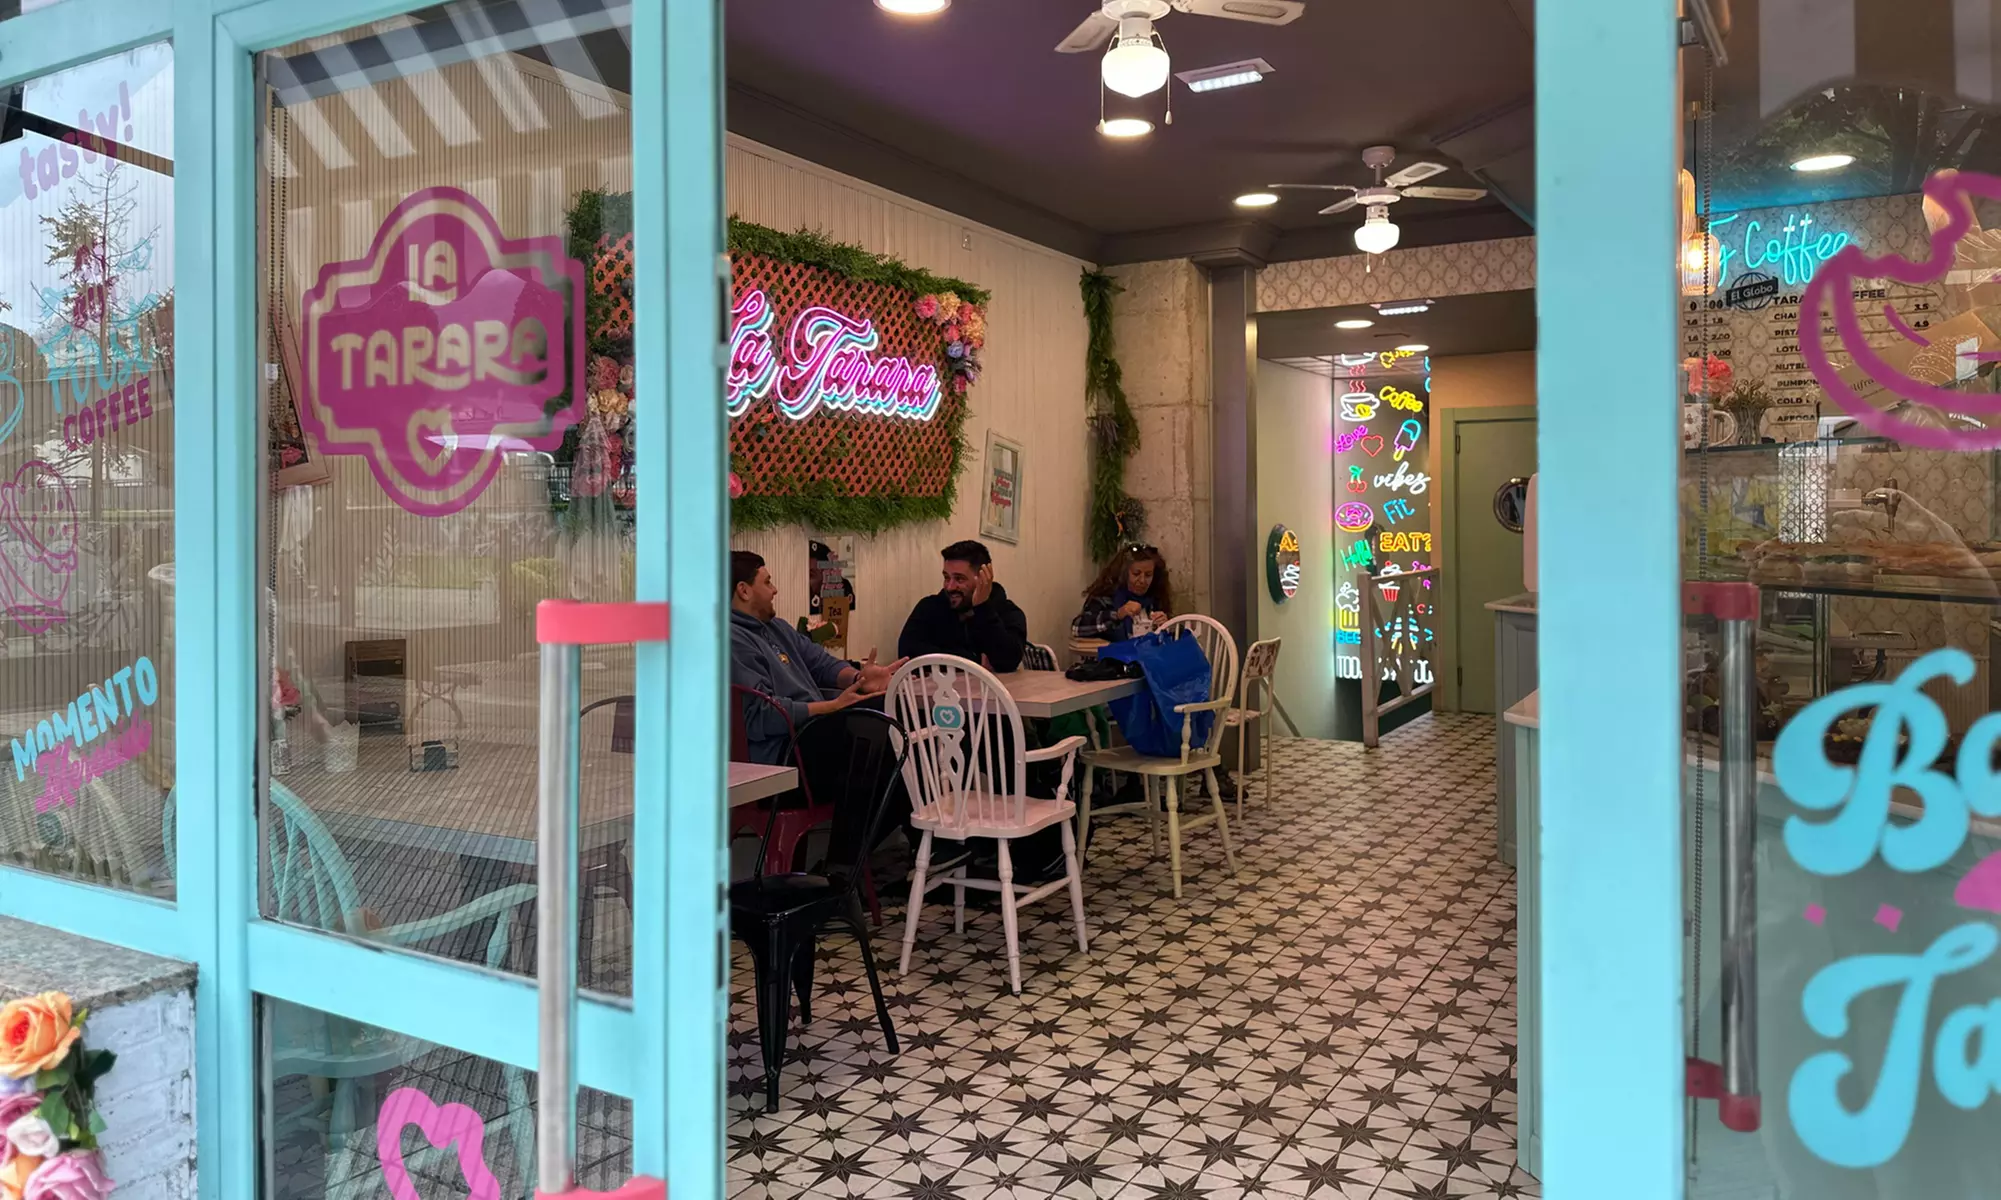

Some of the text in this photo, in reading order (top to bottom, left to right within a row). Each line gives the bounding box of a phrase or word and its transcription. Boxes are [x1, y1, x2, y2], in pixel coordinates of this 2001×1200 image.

[19, 80, 134, 200] tasty!
[408, 240, 457, 306] LA
[1745, 213, 1851, 286] Coffee
[1730, 285, 1774, 302] El Globo
[1773, 289, 1885, 305] TARA FFEE
[1774, 312, 1797, 320] CHAI
[330, 317, 548, 391] TARARA
[775, 306, 942, 421] Tarara
[1776, 345, 1802, 353] LOTU
[64, 377, 153, 451] COFFEE
[1380, 386, 1423, 413] Coffee
[1334, 425, 1368, 453] Love
[1374, 461, 1431, 494] vibes
[11, 656, 158, 782] MOMENTO
